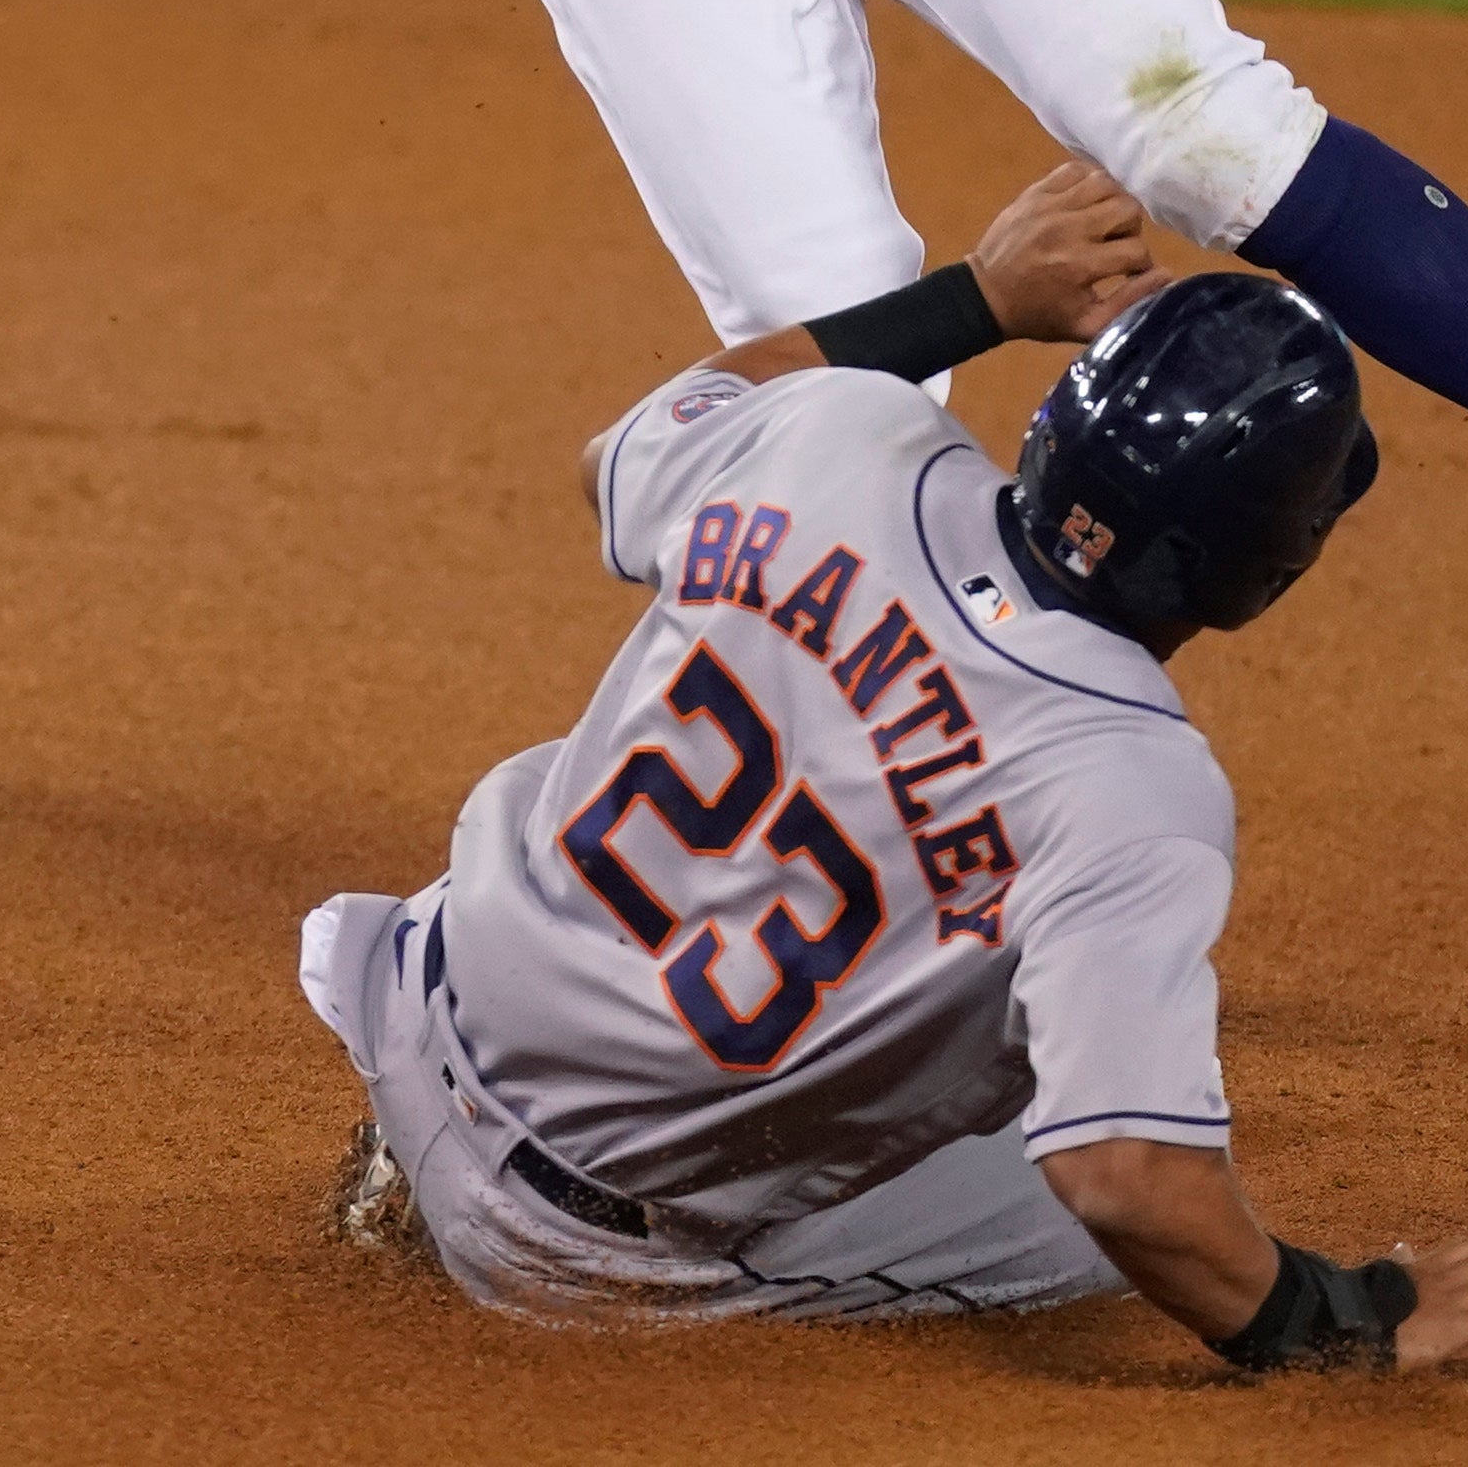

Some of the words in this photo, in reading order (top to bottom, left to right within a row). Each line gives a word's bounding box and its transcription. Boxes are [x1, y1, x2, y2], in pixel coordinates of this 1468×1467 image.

[678, 500, 1021, 948] BRANTLEY
[1061, 503, 1115, 561] 23
[557, 638, 888, 1073] 23
